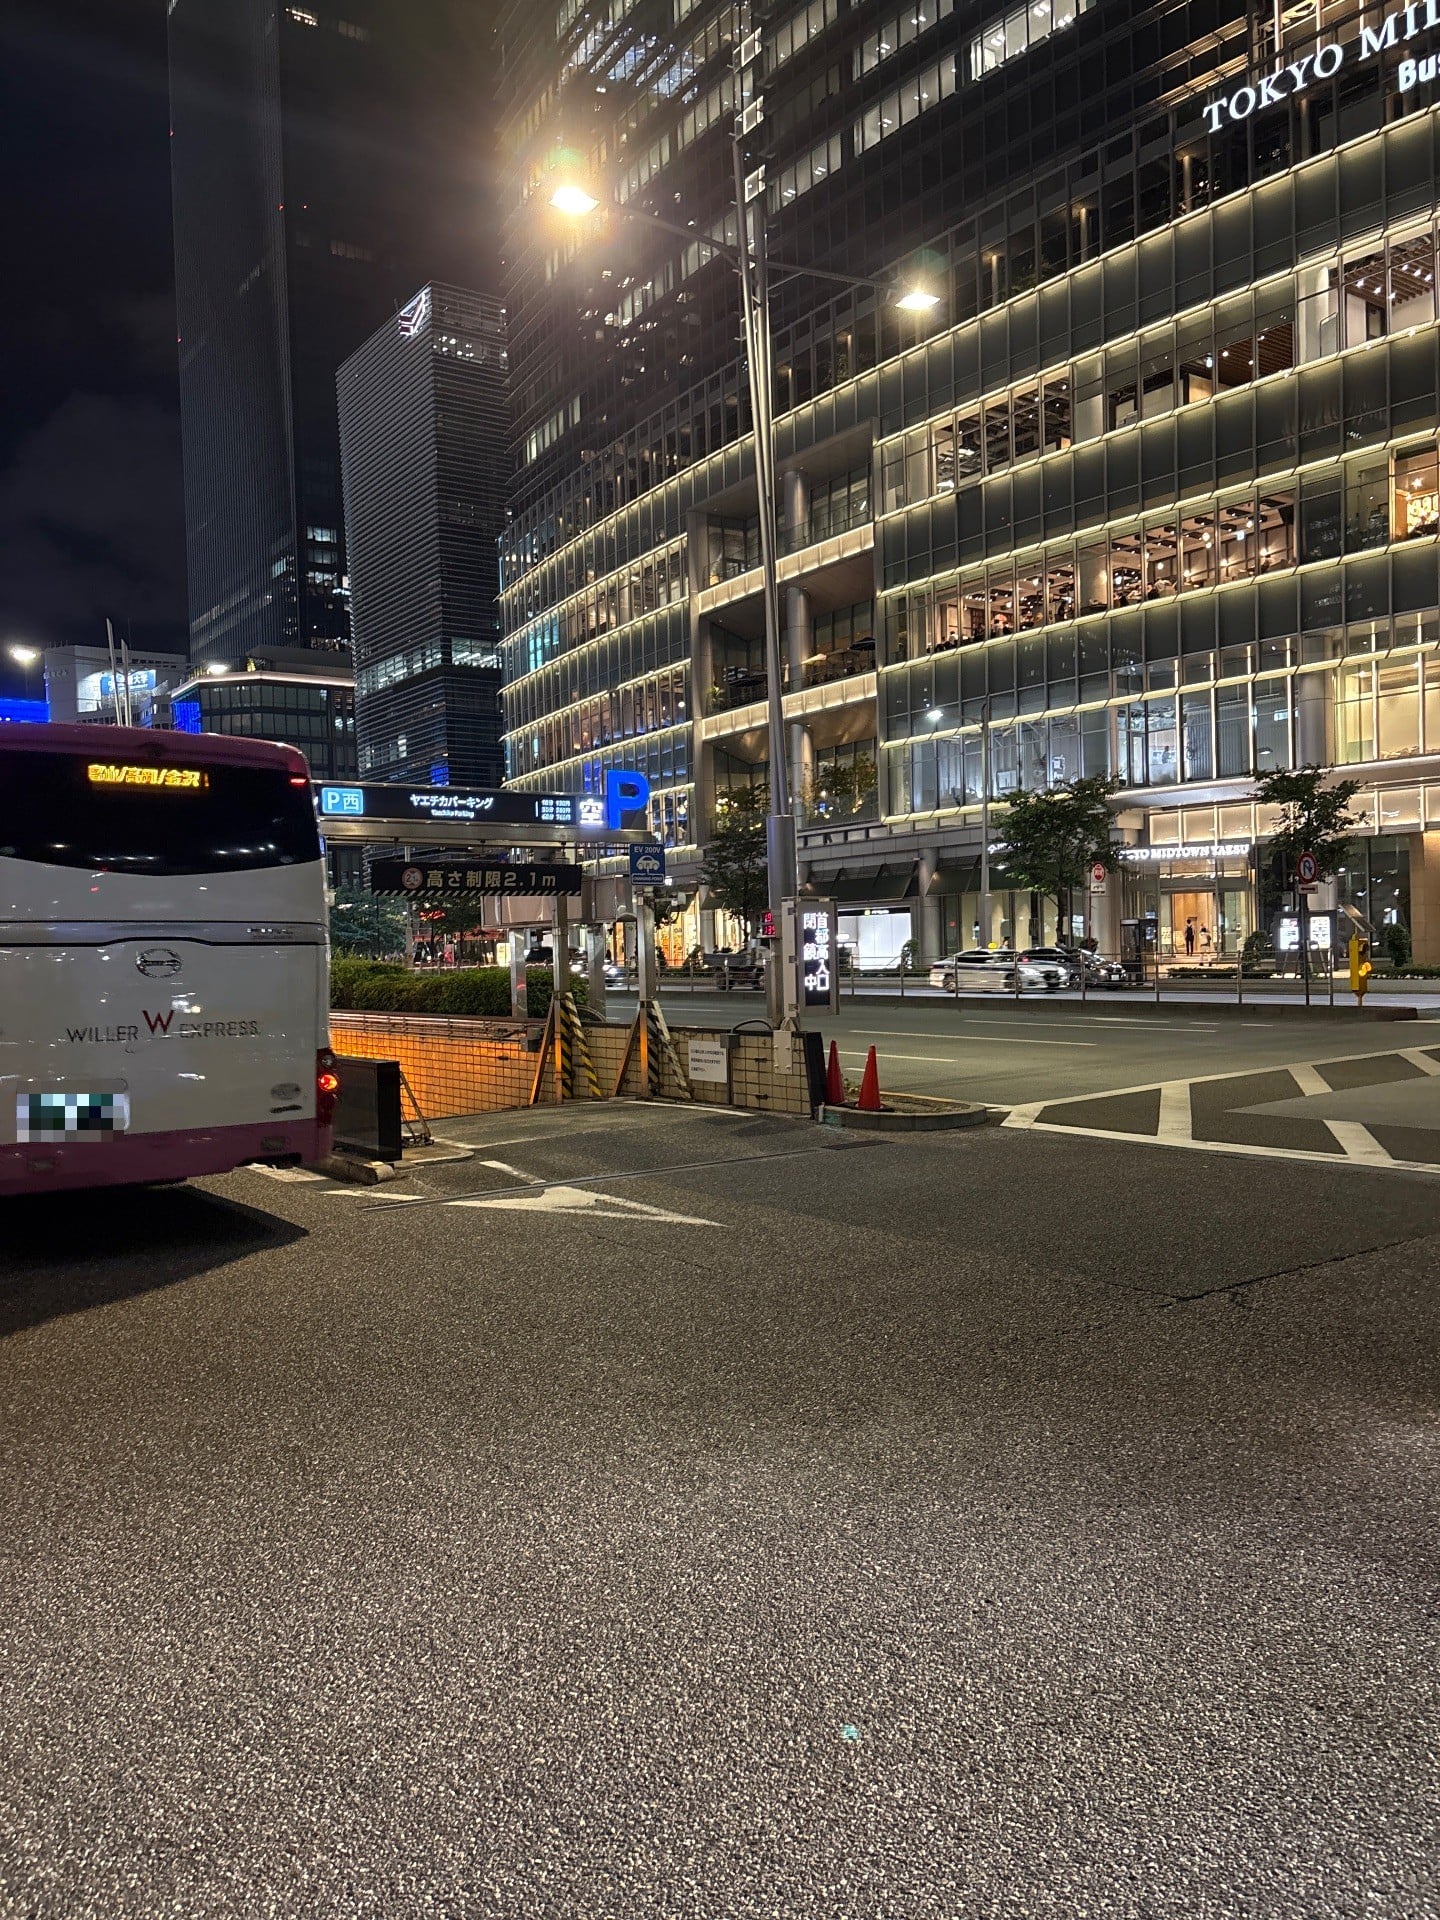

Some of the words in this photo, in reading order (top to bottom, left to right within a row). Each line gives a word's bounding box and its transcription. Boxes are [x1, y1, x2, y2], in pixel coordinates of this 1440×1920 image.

[1202, 44, 1343, 134] TOKYO
[579, 798, 603, 824] 空
[607, 769, 650, 830] P
[1150, 846, 1210, 859] MIDTOWN
[815, 912, 831, 991] 首都高入口
[66, 1025, 139, 1043] WILLER
[142, 1009, 174, 1035] W
[179, 1020, 260, 1039] EXPRESS
